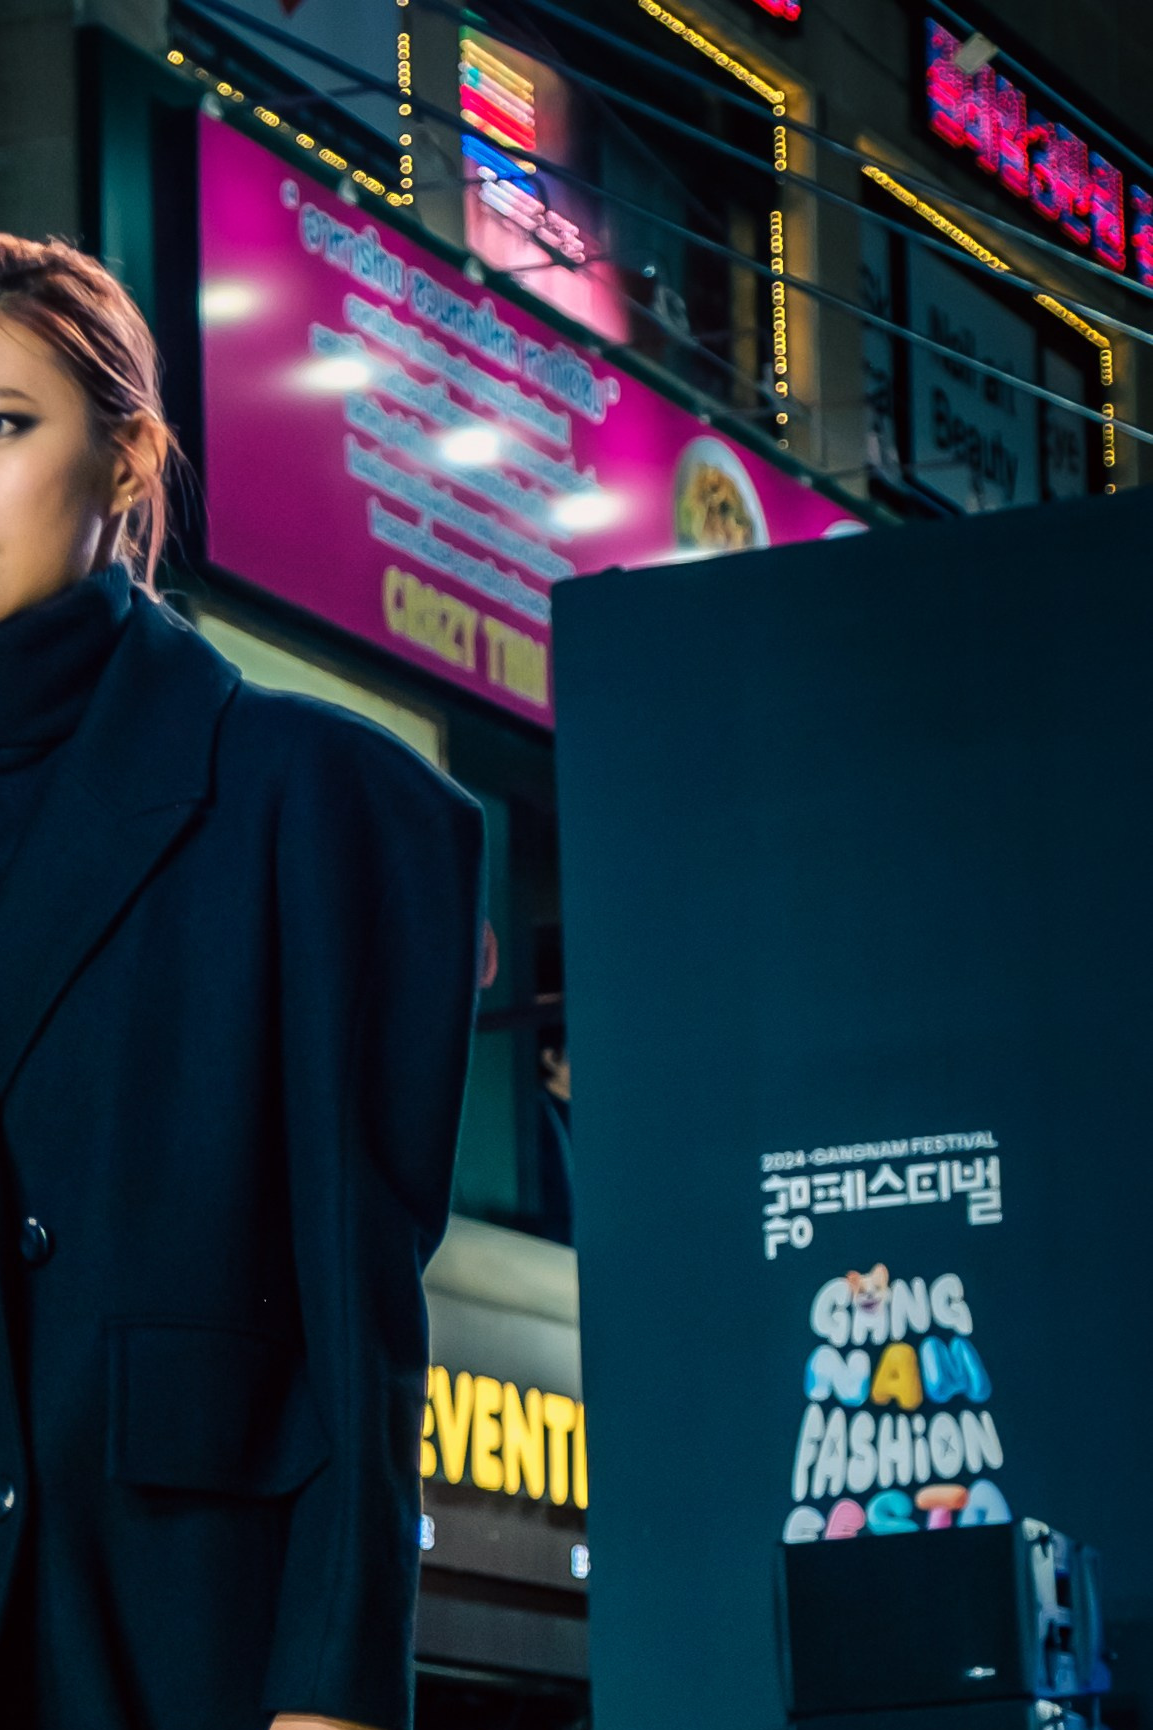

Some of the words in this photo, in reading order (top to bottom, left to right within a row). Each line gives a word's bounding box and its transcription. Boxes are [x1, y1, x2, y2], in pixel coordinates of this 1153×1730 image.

[932, 384, 1020, 496] Beauty
[760, 1149, 806, 1173] 2024
[811, 1138, 908, 1167] GANGNAM
[910, 1129, 999, 1157] FESTIVAL
[810, 1268, 974, 1348] GANG
[803, 1335, 993, 1412] NAM
